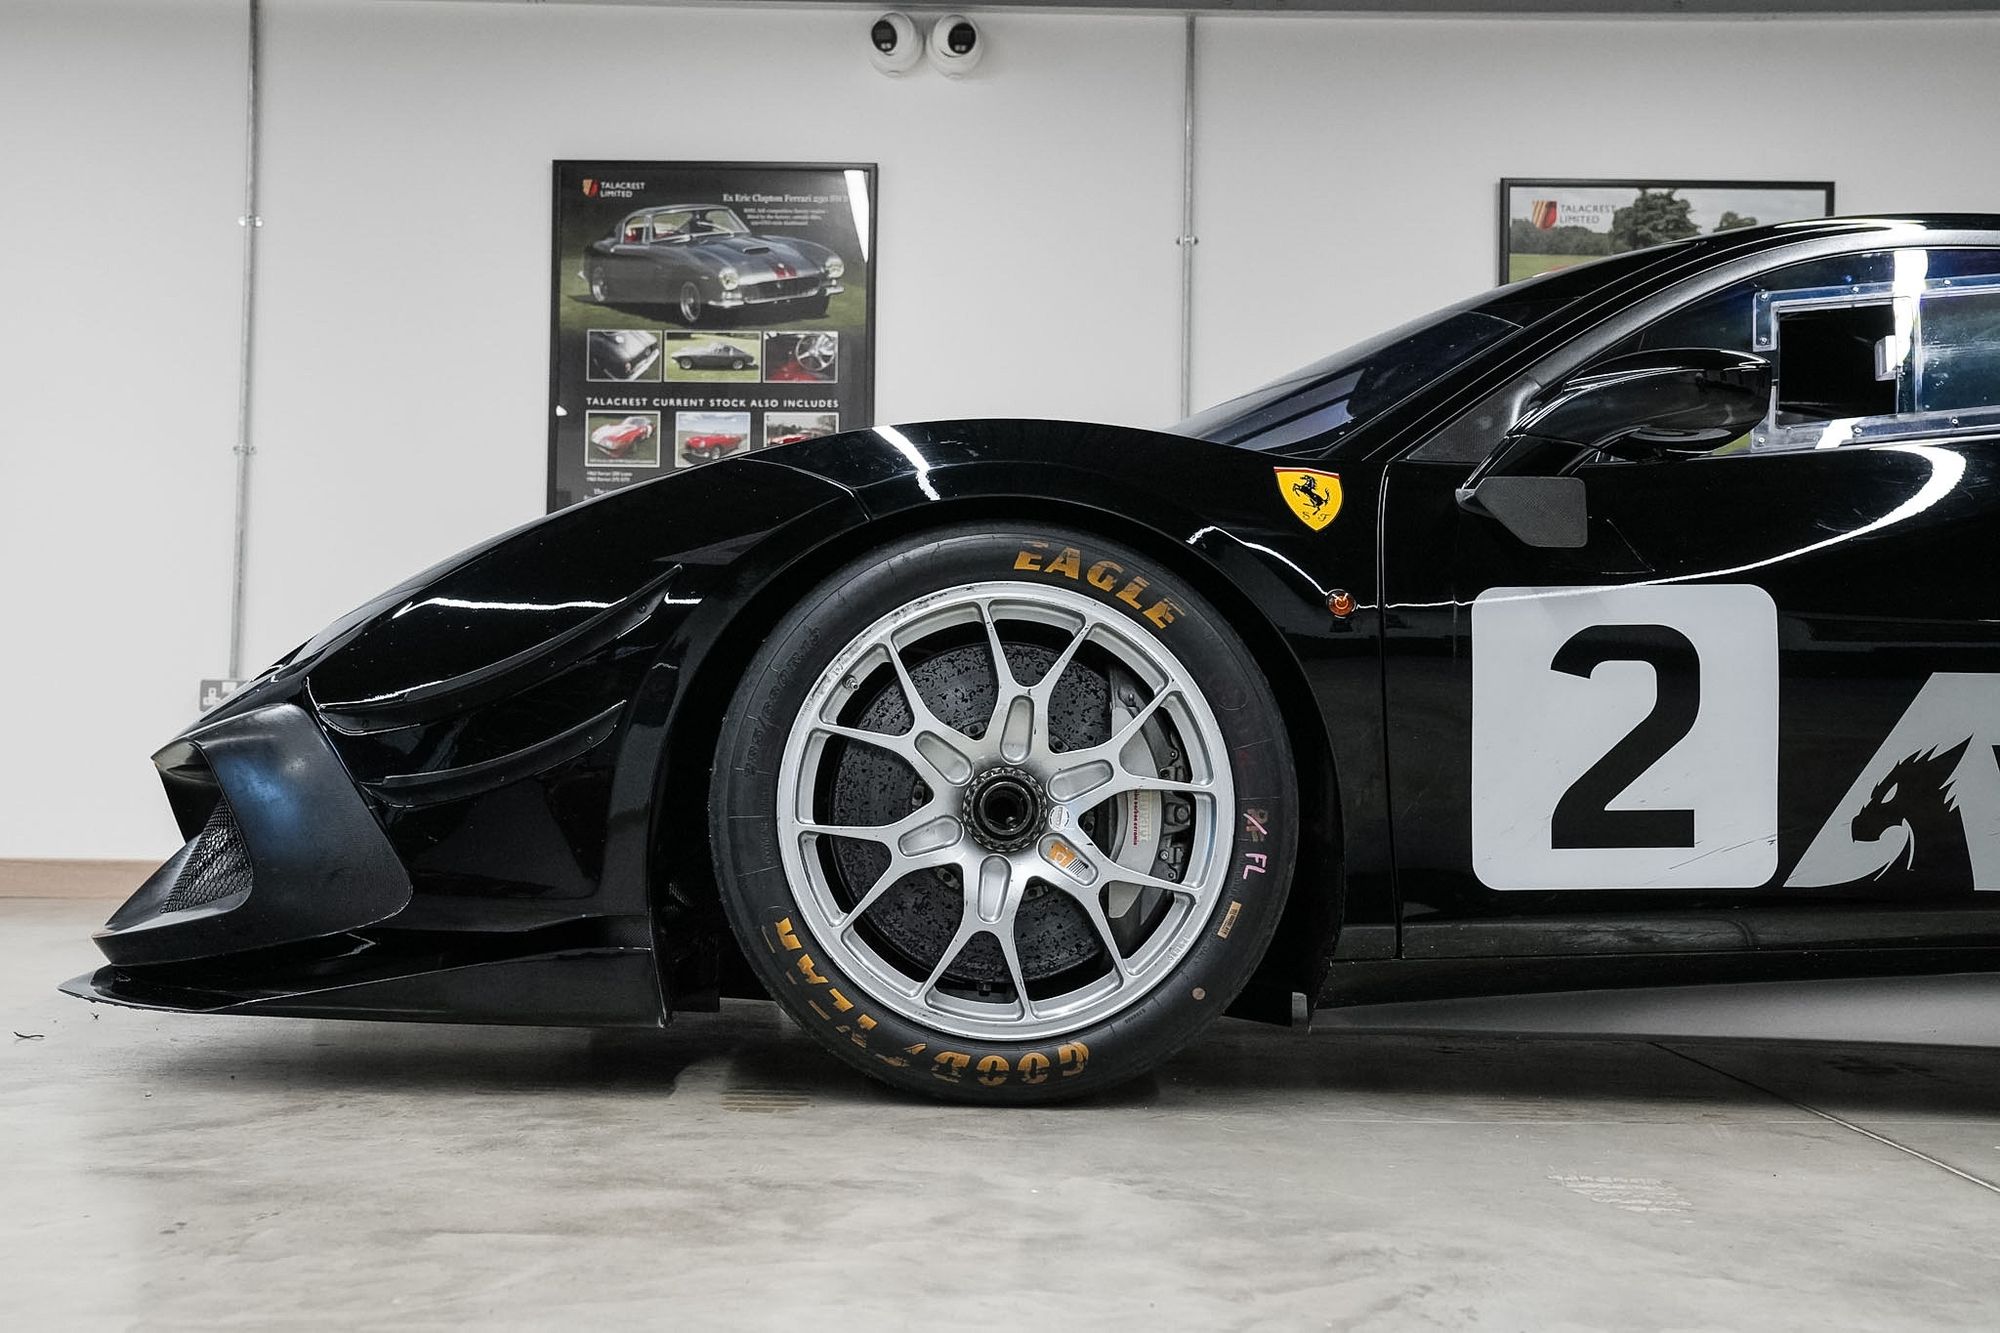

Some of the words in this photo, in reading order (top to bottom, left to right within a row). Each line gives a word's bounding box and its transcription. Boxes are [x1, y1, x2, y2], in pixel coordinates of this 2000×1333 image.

[600, 182, 646, 190] TALACREST
[600, 190, 633, 198] LIMITED
[1561, 204, 1616, 213] TALACREST
[1560, 215, 1601, 224] LIMITED
[586, 397, 648, 406] TALACREST
[652, 398, 705, 407] CURRENT
[709, 399, 746, 408] STOCK
[750, 399, 779, 408] ALSO
[783, 399, 840, 408] INCLUDES
[1014, 540, 1186, 630] EAGLE
[1550, 624, 1701, 850] 2
[1243, 853, 1267, 880] FL
